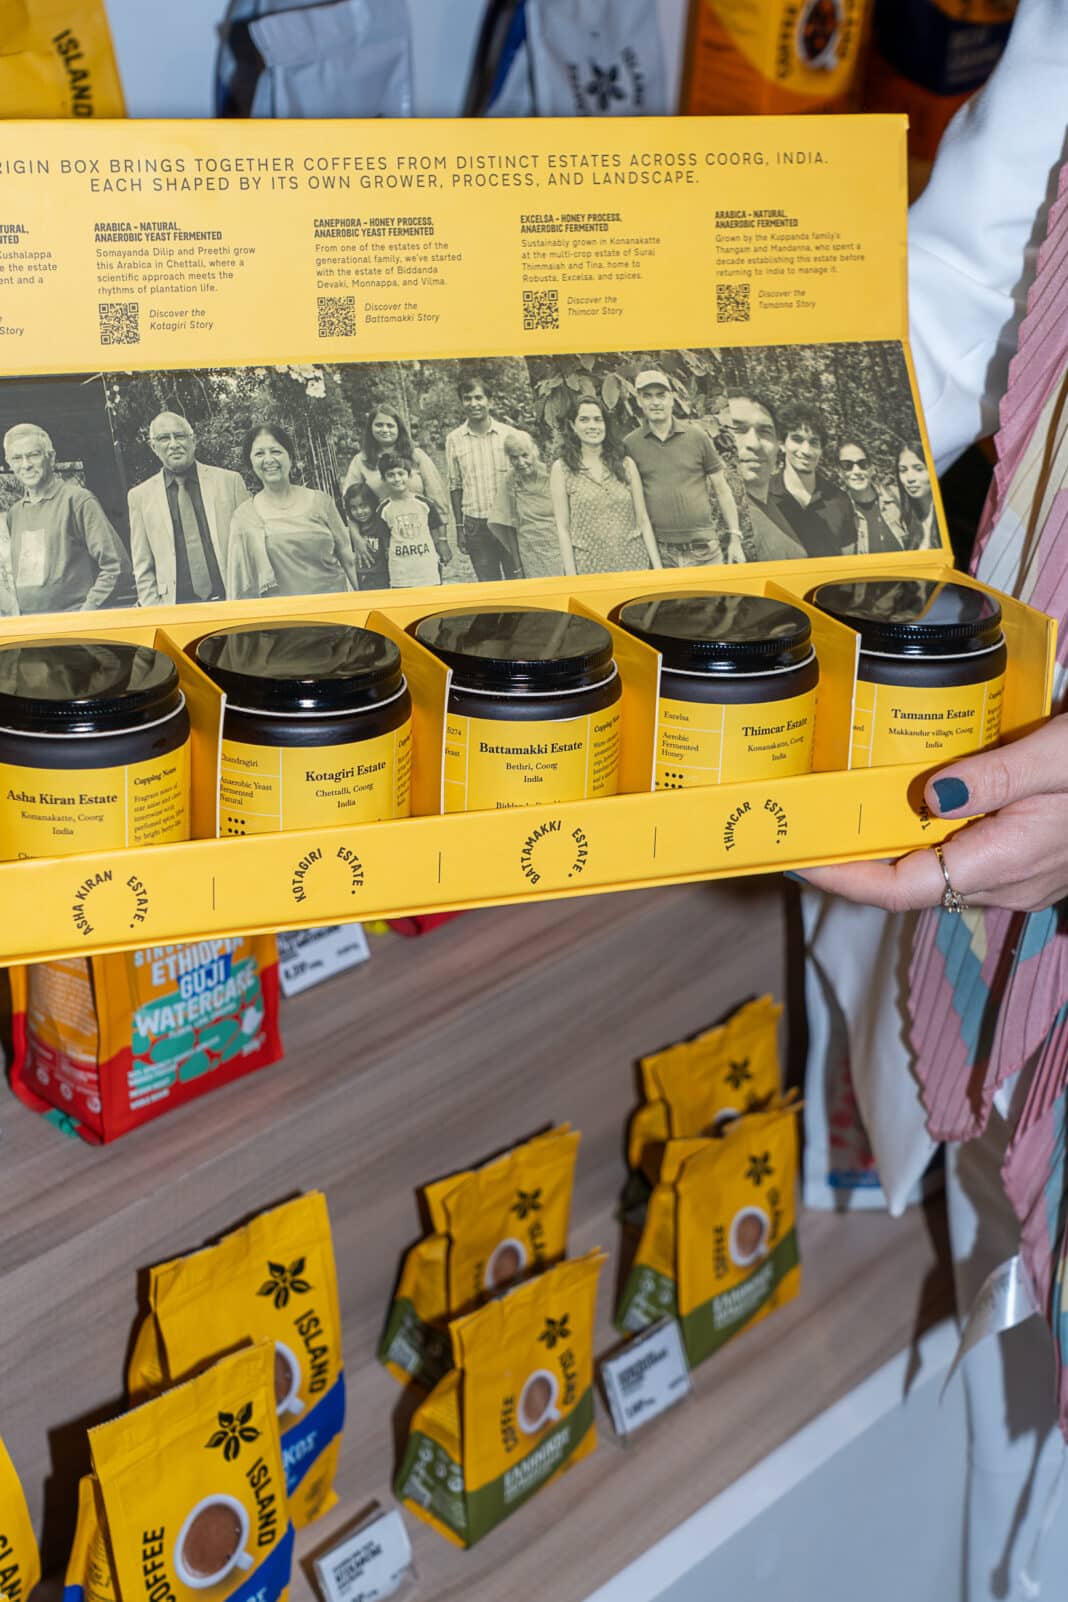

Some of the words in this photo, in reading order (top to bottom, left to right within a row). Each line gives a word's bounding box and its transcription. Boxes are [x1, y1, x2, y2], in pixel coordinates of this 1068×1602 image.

[52, 29, 94, 117] ISLAND
[60, 159, 100, 174] BOX
[110, 159, 185, 173] BRINGS
[194, 158, 294, 172] TOGETHER
[304, 156, 387, 171] COFFEES
[397, 157, 447, 170] FROM
[457, 155, 540, 169] DISTINCT
[548, 154, 621, 168] ESTATES
[630, 153, 697, 167] ACROSS
[705, 152, 769, 167] COORG,
[777, 151, 829, 165] INDIA.
[90, 178, 142, 192] EACH
[153, 177, 230, 191] SHAPED
[240, 177, 262, 191] BY
[272, 176, 298, 190] ITS
[308, 175, 350, 189] OWN
[360, 175, 443, 188] GROWER,
[453, 173, 540, 187] PROCESS,
[548, 172, 584, 185] AND
[592, 170, 699, 187] LANDSCAPE.
[314, 218, 361, 228] CANEPHORA
[370, 218, 394, 226] HONEY
[520, 215, 553, 223] EXCELSA
[561, 214, 584, 222] HONEY
[95, 223, 131, 232] ARABICA
[314, 228, 359, 238] ANAEROBIC
[362, 228, 386, 237] YEAST
[388, 227, 434, 236] FERMENTED
[521, 224, 563, 233] ANAEROBIC
[565, 223, 608, 232] FERMENTED
[95, 232, 142, 243] ANAEROBIC
[146, 232, 171, 241] YEAST
[173, 231, 222, 240] FERMENTED
[96, 249, 149, 258] Somayanda
[153, 248, 174, 257] Dilip
[198, 247, 230, 255] Preethi
[233, 248, 256, 256] grow
[315, 244, 337, 252] From
[360, 243, 368, 251] of
[372, 243, 385, 251] the
[389, 242, 420, 250] estates
[97, 261, 114, 270] this
[117, 261, 152, 269] Arabica
[156, 260, 163, 268] in
[209, 259, 236, 267] where
[316, 255, 371, 266] generational
[431, 253, 462, 261] started
[97, 273, 139, 282] scientific
[142, 272, 185, 282] approach
[188, 272, 216, 280] meets
[219, 271, 233, 280] the
[317, 268, 334, 277] with
[337, 268, 351, 276] the
[355, 267, 382, 275] estate
[98, 286, 135, 296] rhythms
[138, 285, 147, 293] of
[150, 284, 197, 294] plantation
[365, 303, 401, 311] Discover
[405, 302, 417, 310] the
[149, 310, 188, 318] Discover
[192, 308, 205, 317] the
[417, 313, 440, 322] Story
[150, 322, 187, 332] Kotagiri
[190, 320, 213, 330] Story
[395, 544, 429, 557] BARÇA
[892, 708, 944, 720] Tamanna
[946, 709, 975, 719] Estate
[742, 725, 785, 737] Thimcar
[786, 716, 808, 731] Estate
[480, 742, 548, 755] Battamakki
[551, 742, 583, 753] Estate
[305, 768, 354, 783] Kotagiri
[357, 761, 387, 775] Estate
[524, 775, 543, 783] India
[7, 790, 35, 803] Asha
[40, 794, 75, 805] Kiran
[79, 794, 117, 805] Estate
[723, 802, 752, 852] THIMCAR
[521, 820, 562, 885] BATTAMAKKI
[292, 848, 323, 903] KOTAGIRI
[79, 869, 113, 900] KIRAN
[72, 903, 94, 936] ASHA
[180, 959, 226, 999] GUJI
[293, 1309, 332, 1394] ISLAND
[245, 1457, 276, 1547] ISLAND
